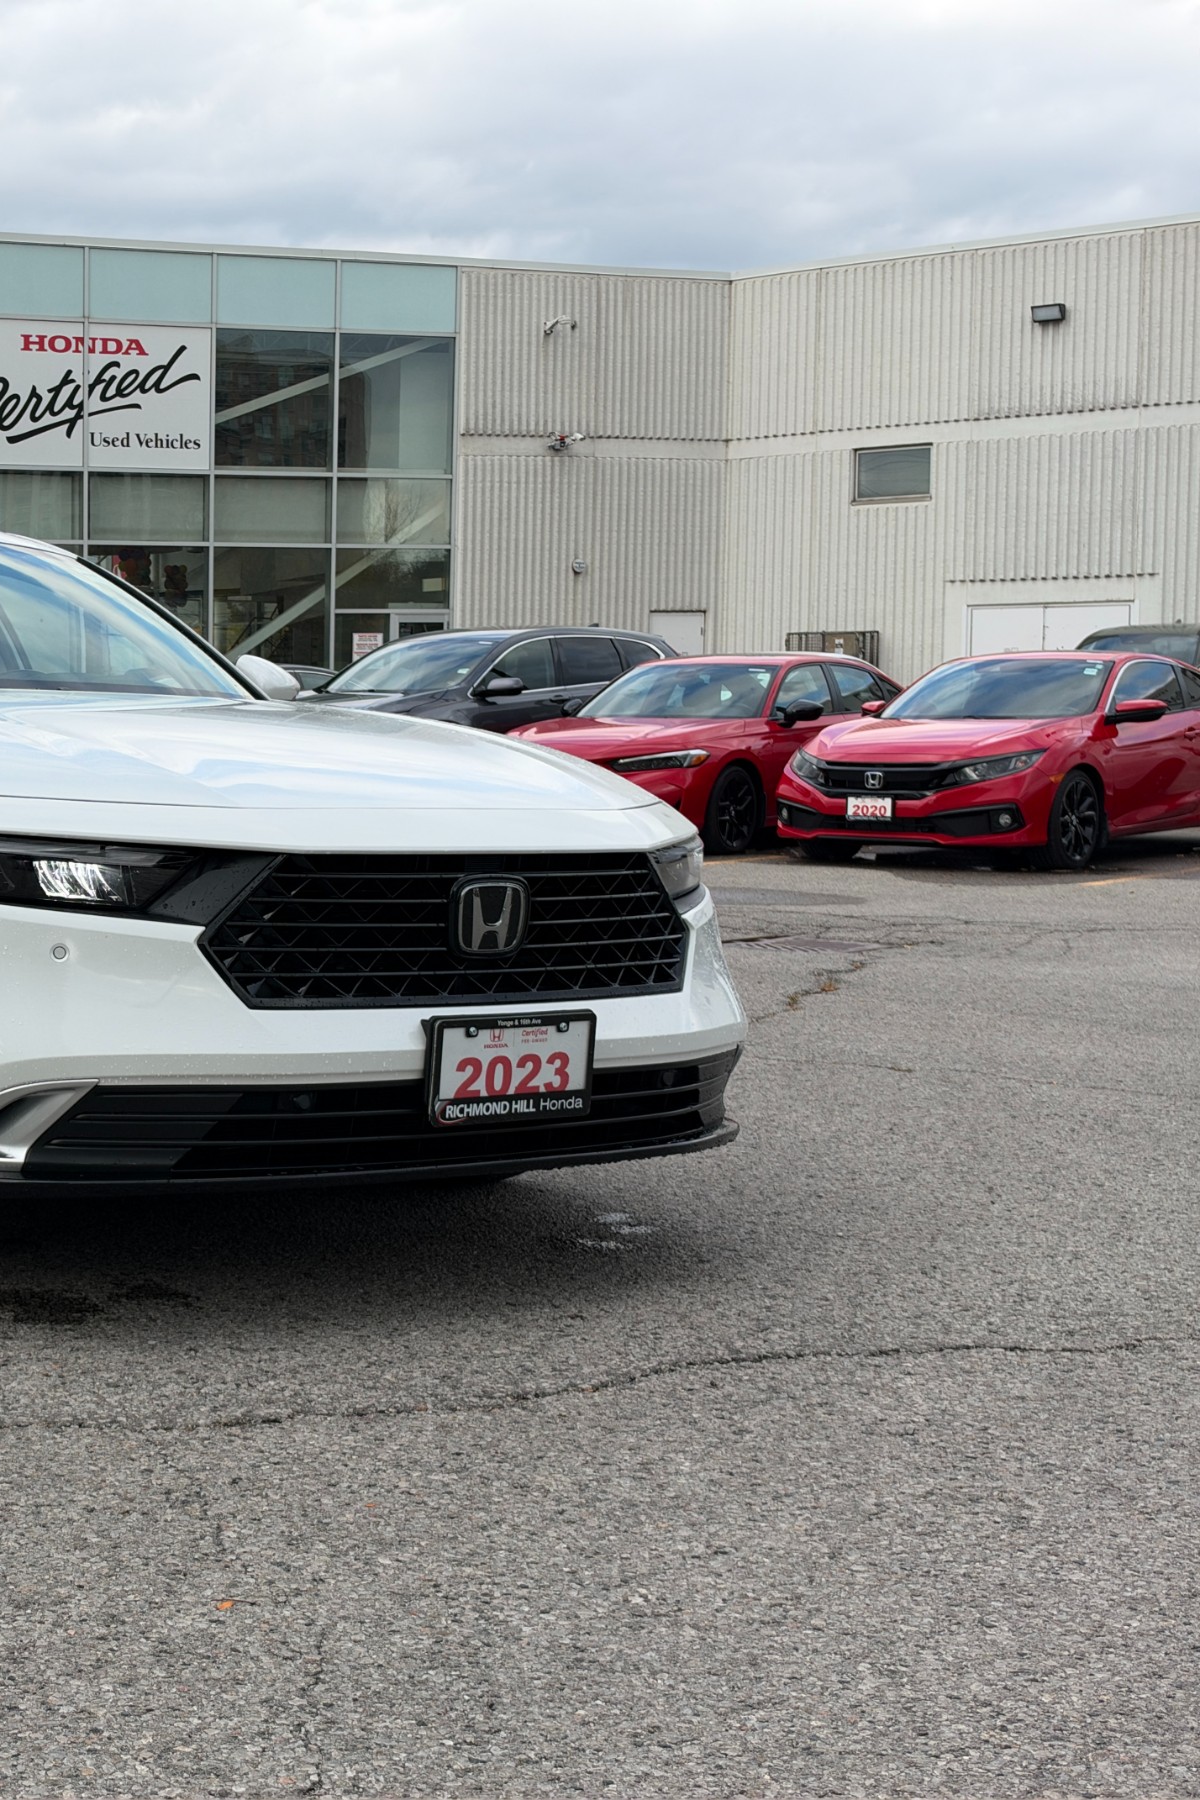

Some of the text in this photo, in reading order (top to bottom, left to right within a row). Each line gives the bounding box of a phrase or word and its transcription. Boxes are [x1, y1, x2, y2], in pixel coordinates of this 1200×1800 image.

[20, 334, 149, 356] HONDA
[89, 432, 201, 450] Used Vehicles
[852, 804, 887, 817] 2020
[497, 1019, 513, 1027] Yonge
[521, 1027, 548, 1037] Certified
[453, 1051, 570, 1099] 2023
[445, 1096, 583, 1119] RICHMOND HILL Honda
